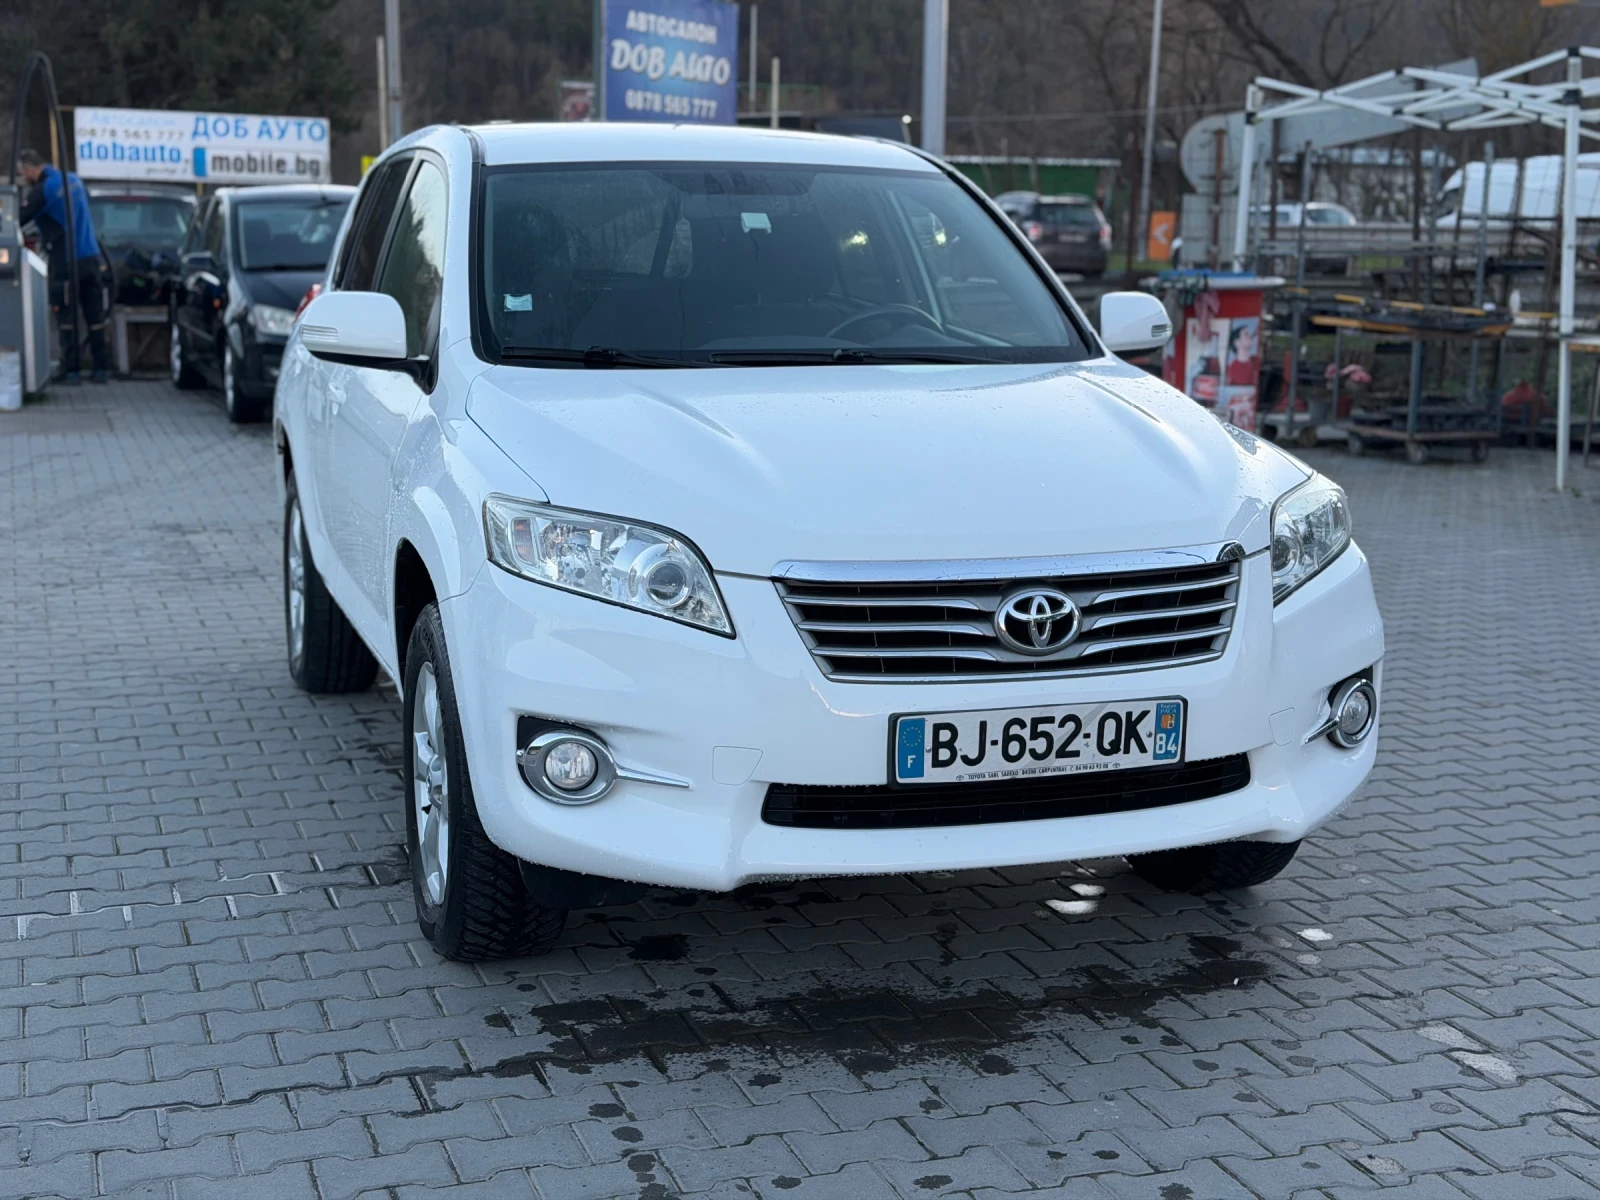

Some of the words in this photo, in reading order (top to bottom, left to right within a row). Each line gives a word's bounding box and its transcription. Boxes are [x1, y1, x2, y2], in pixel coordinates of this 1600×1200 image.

[625, 9, 718, 45] АВТОСАЛОН
[625, 89, 663, 113] 0878
[692, 98, 718, 119] 777
[78, 127, 118, 138] 0878
[123, 128, 153, 140] 565
[157, 130, 186, 141] 777
[191, 115, 250, 142] ДОБ
[257, 119, 326, 142] АУТО
[211, 149, 321, 177] mobile.bg
[907, 754, 916, 768] F
[931, 709, 1151, 768] BJ-652-QK
[1155, 732, 1177, 755] 84
